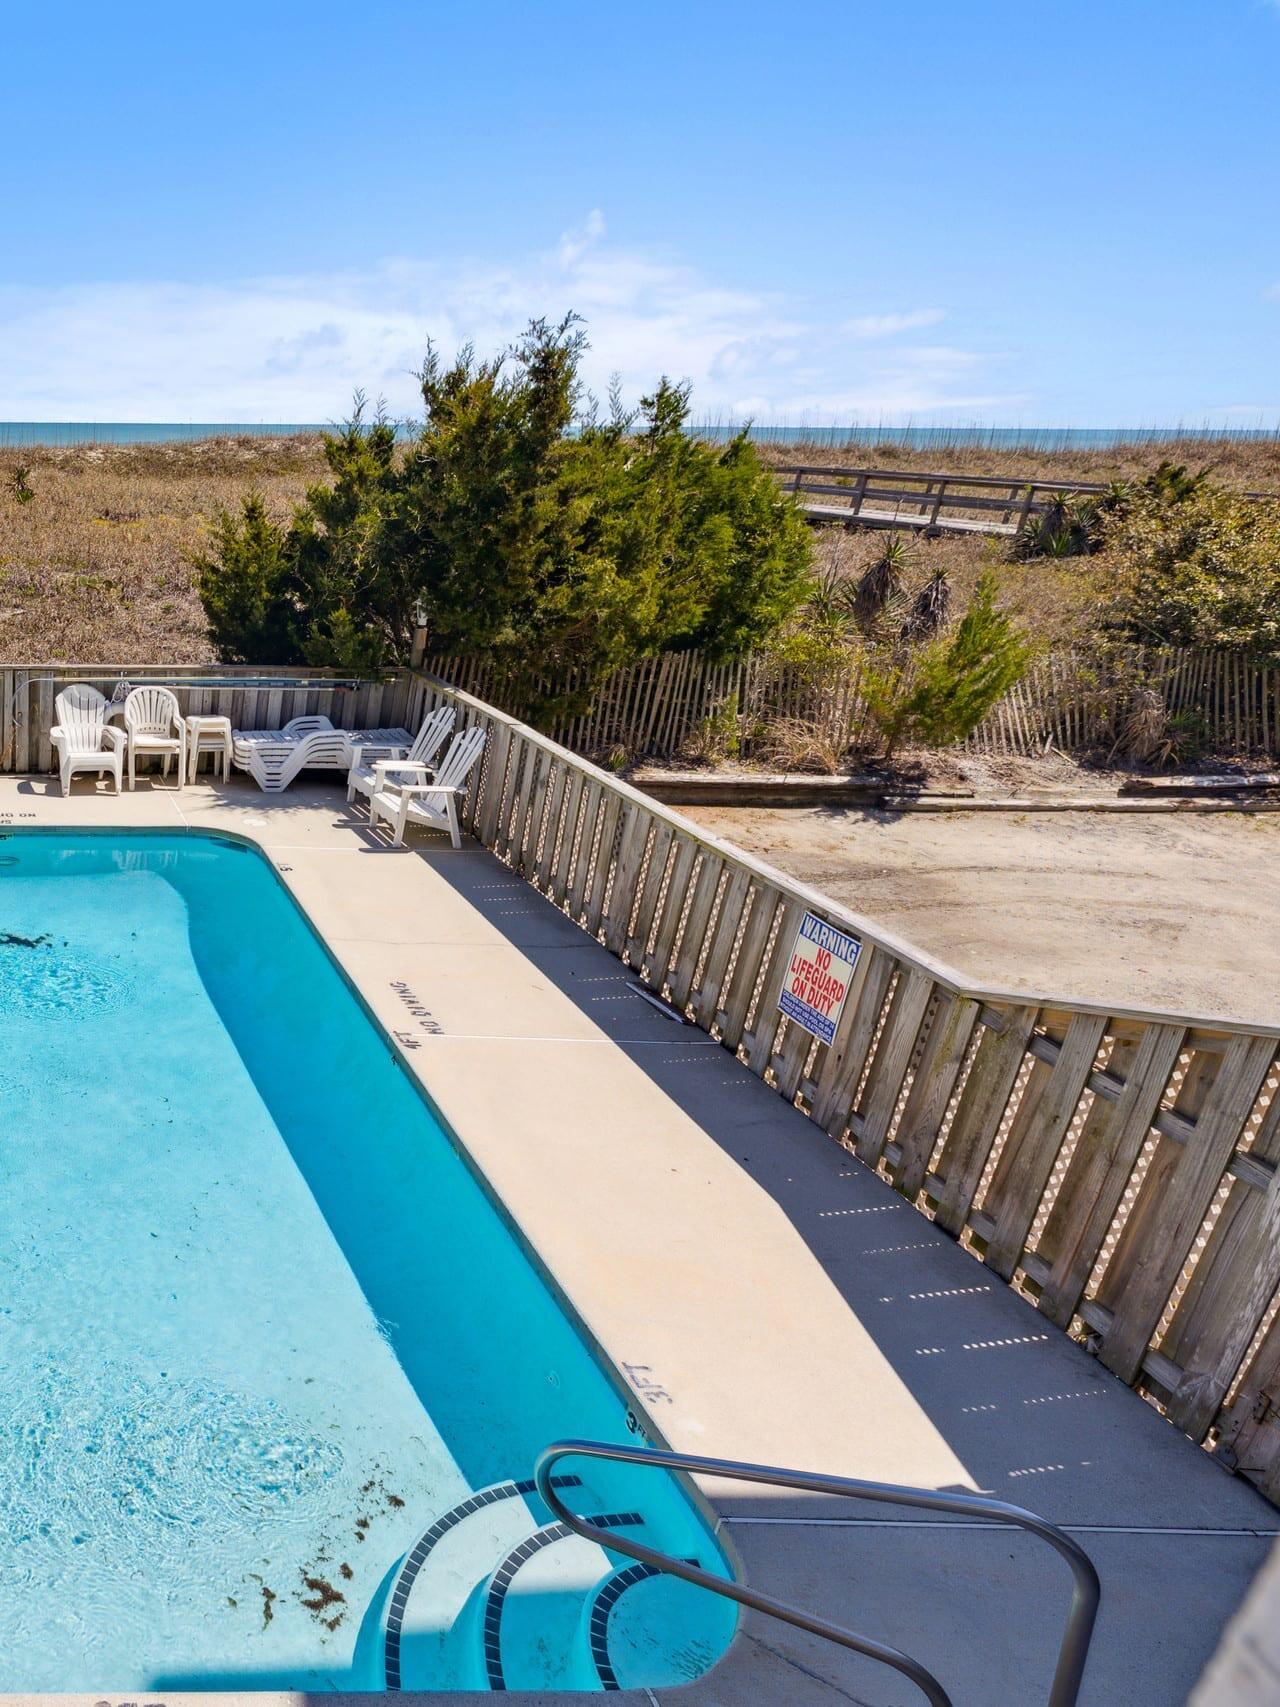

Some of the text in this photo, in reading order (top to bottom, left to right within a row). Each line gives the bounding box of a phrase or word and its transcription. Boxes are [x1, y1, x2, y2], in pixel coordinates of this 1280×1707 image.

[802, 916, 857, 965] WARNING
[815, 947, 832, 971] NO
[790, 954, 845, 1003] LIFEGUARD
[791, 976, 834, 1017] ON DUTY
[390, 981, 445, 1034] NO DIVING
